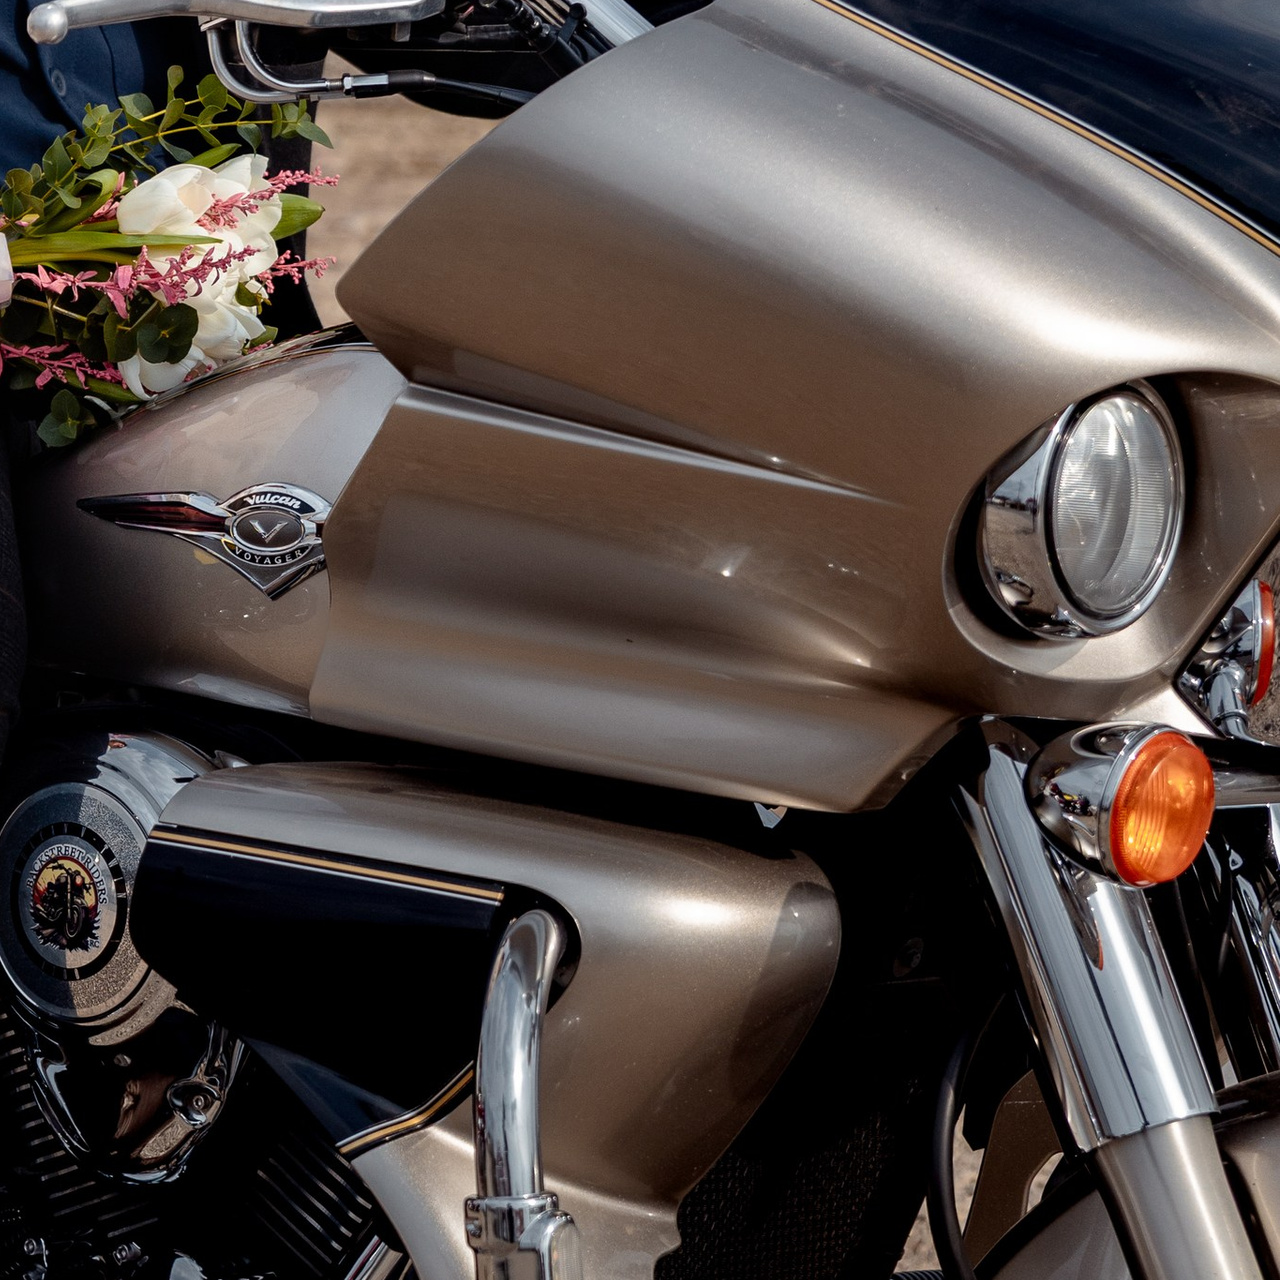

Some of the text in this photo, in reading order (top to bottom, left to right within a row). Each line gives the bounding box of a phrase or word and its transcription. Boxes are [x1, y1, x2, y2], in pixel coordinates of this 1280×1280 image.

[243, 493, 301, 509] Vulcan
[234, 546, 303, 565] VOYAGER
[26, 844, 108, 905] BACKSTREET RIDERS
